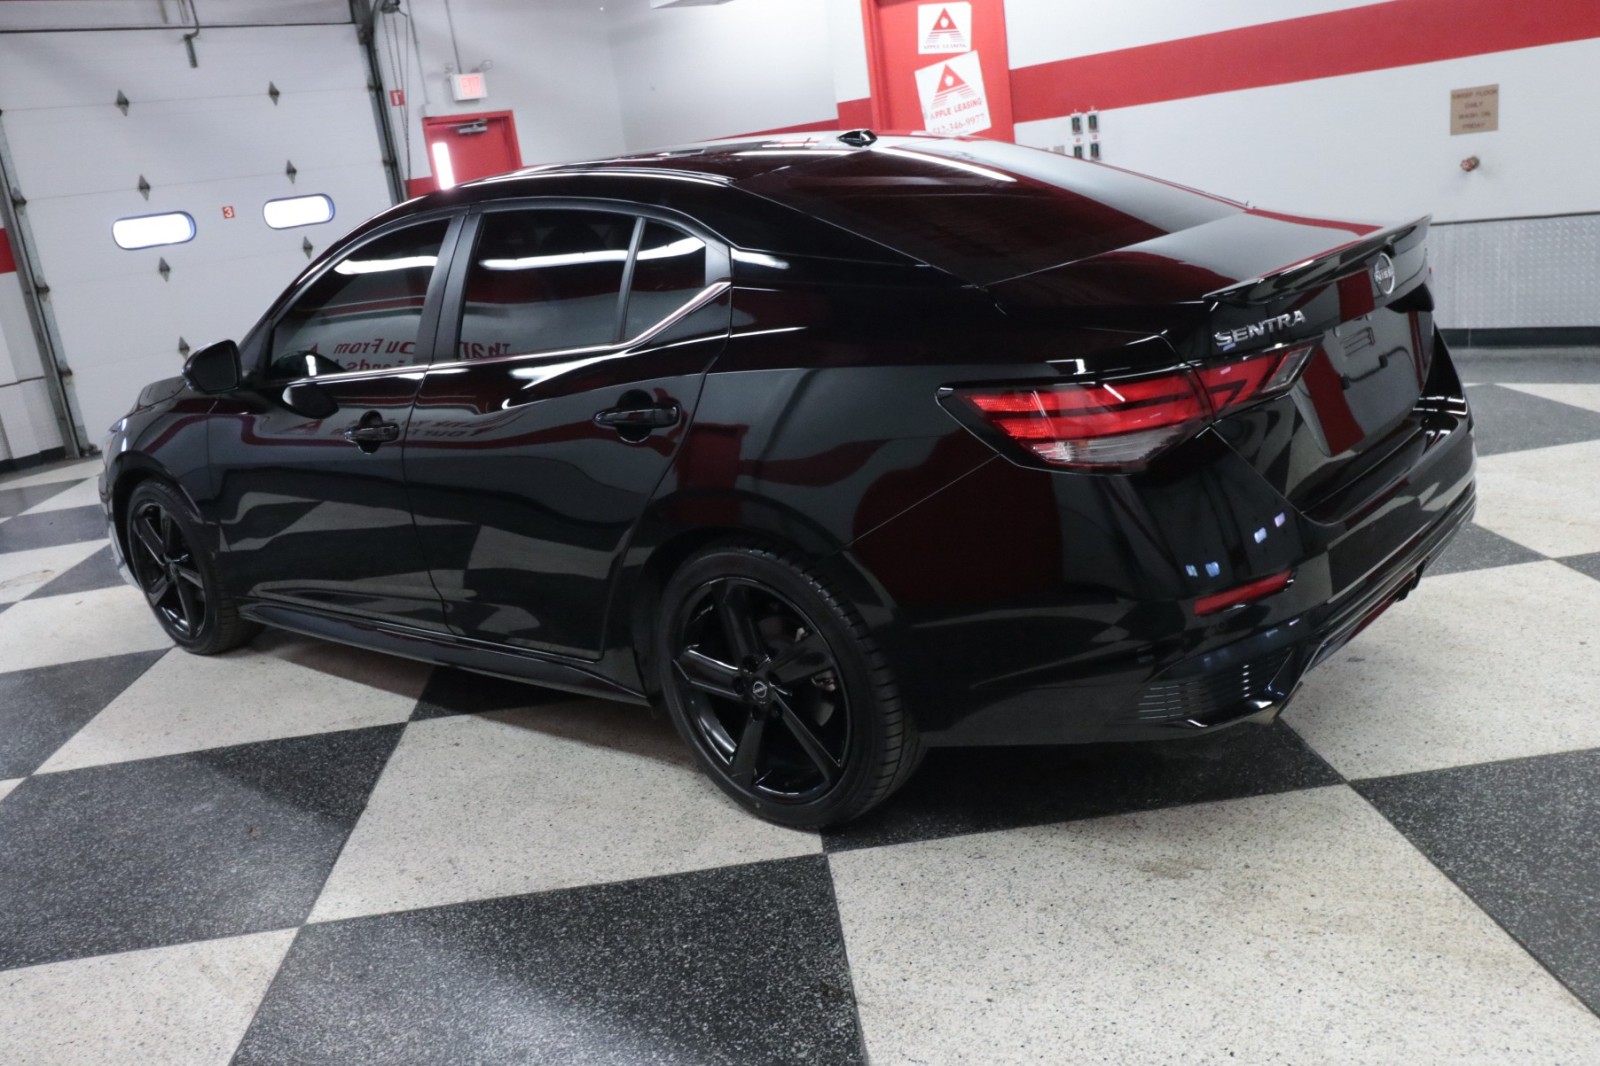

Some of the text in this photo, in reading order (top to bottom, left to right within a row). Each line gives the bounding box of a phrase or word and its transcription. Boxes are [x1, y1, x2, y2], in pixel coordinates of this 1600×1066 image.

[930, 97, 982, 120] APPLE LEASING
[224, 207, 233, 218] 3
[1214, 310, 1306, 346] SENTRA
